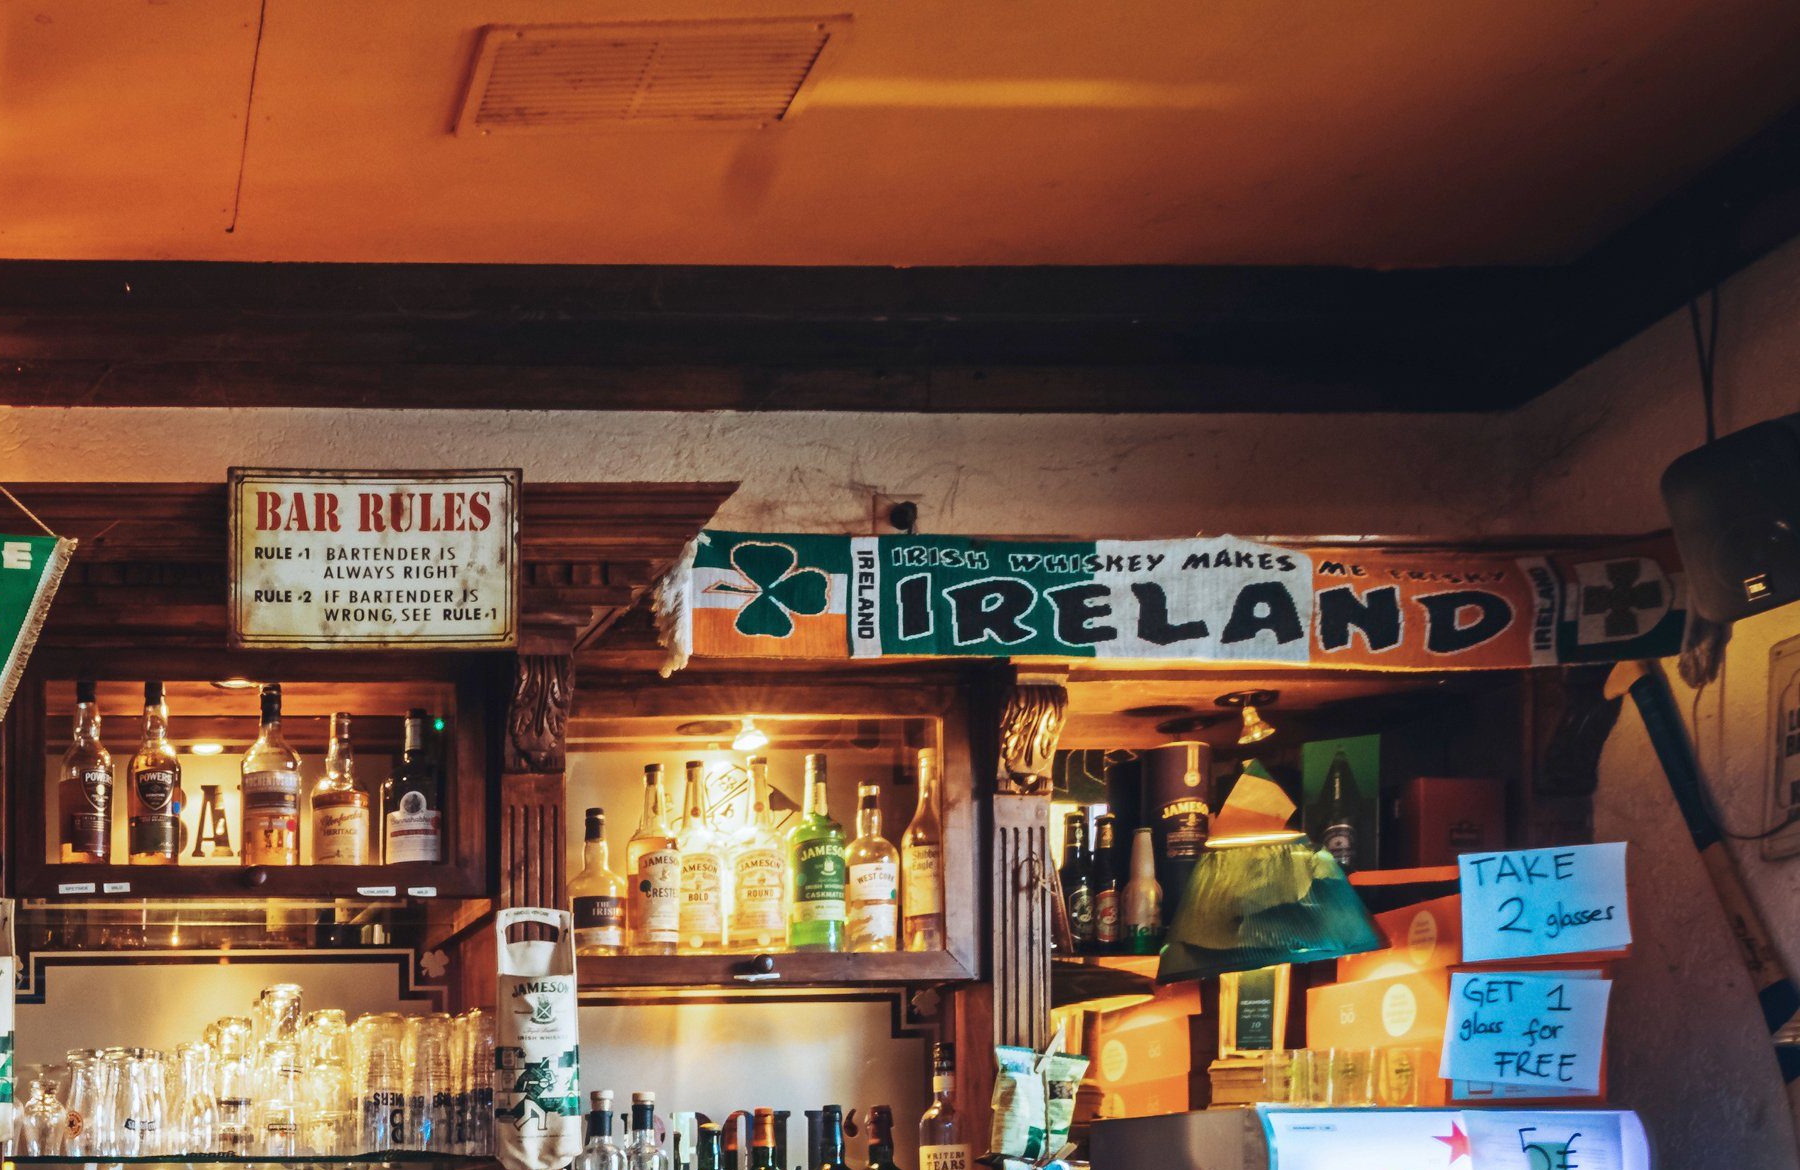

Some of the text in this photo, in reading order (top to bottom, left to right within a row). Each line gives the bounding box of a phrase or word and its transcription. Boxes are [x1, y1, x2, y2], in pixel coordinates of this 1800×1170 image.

[255, 491, 491, 532] BAR RULES
[254, 547, 292, 560] RULE
[326, 547, 430, 561] BARTENDER
[440, 547, 456, 560] IS
[892, 546, 990, 570] IRISH
[1007, 552, 1166, 575] WHISKEY
[1182, 547, 1298, 573] MAKES
[1318, 559, 1368, 578] ME
[323, 565, 458, 579] ALWAYS RIGHT
[254, 590, 292, 603] RULE
[325, 590, 340, 603] IF
[350, 590, 453, 603] BARTENDER
[462, 589, 478, 602] IS
[855, 550, 876, 641] IRELAND
[324, 609, 397, 624] WRONG,
[402, 608, 432, 621] SEE
[443, 608, 481, 621] RULE
[896, 571, 1514, 655] IRELAND
[1530, 566, 1557, 651] IRELAND
[138, 771, 173, 785] POWERS
[739, 859, 781, 871] JAMESON
[1470, 853, 1575, 886] TAKE
[856, 872, 876, 884] WEST
[688, 892, 709, 902] BOLD
[591, 906, 621, 917] IRISH
[1497, 896, 1616, 939] 2 glasses
[511, 981, 570, 998] JAMESON
[1462, 978, 1572, 1011] GET 1
[1459, 1011, 1564, 1047] glass for
[1494, 1050, 1577, 1083] FREE
[926, 1159, 967, 1170] TEARS
